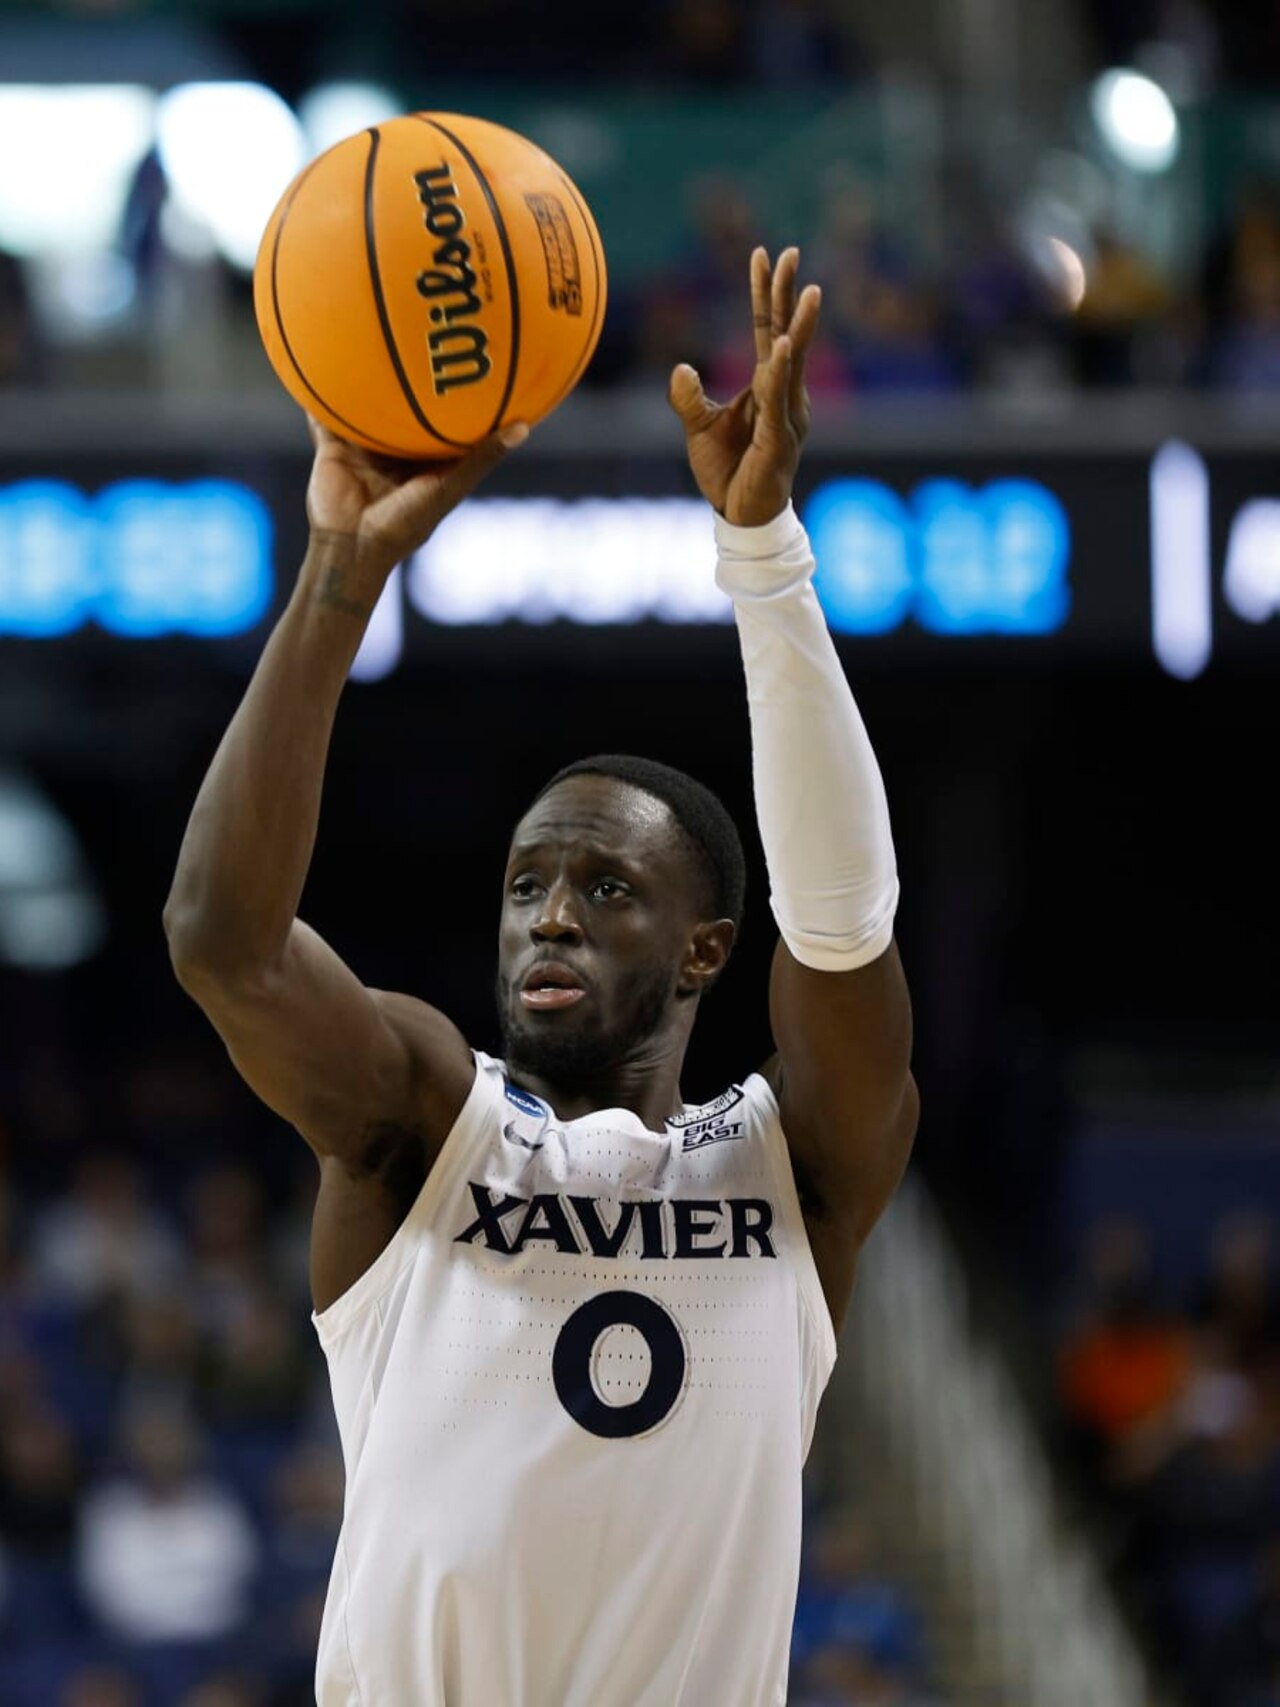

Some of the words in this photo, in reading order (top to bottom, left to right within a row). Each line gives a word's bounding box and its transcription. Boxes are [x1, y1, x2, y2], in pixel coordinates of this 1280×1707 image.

[412, 155, 492, 397] Wilson
[682, 1121, 743, 1147] EAST
[683, 1114, 725, 1137] BIG
[453, 1181, 778, 1260] XAVIER
[552, 1290, 688, 1439] 0
